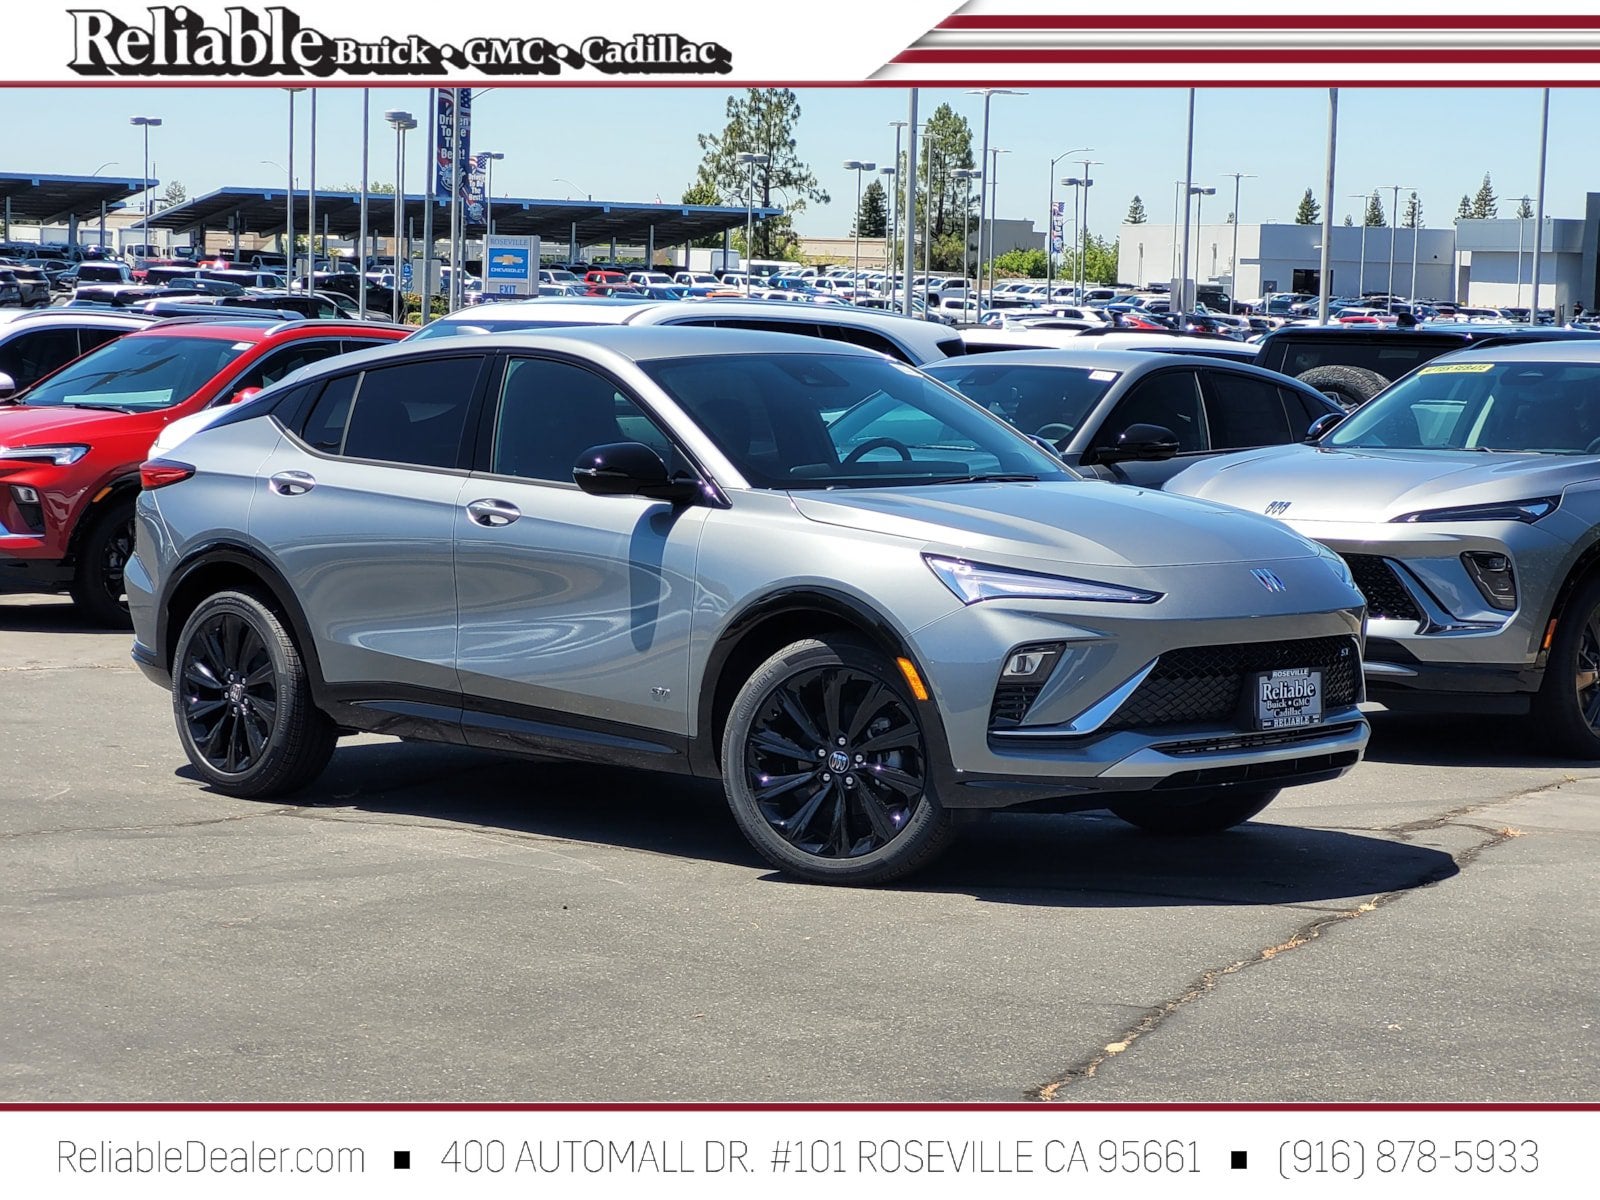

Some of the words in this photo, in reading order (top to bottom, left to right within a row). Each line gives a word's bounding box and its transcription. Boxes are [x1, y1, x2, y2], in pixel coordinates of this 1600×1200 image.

[439, 114, 469, 126] Drien
[490, 238, 529, 246] ROSEVILLE
[499, 284, 517, 294] EXIT
[1272, 669, 1309, 678] ROSEVILLE
[1262, 679, 1316, 701] Reliable
[1266, 698, 1288, 709] Buick
[1292, 696, 1310, 707] GMC
[1273, 707, 1303, 718] Cadillac
[1273, 716, 1310, 728] RELIABLE
